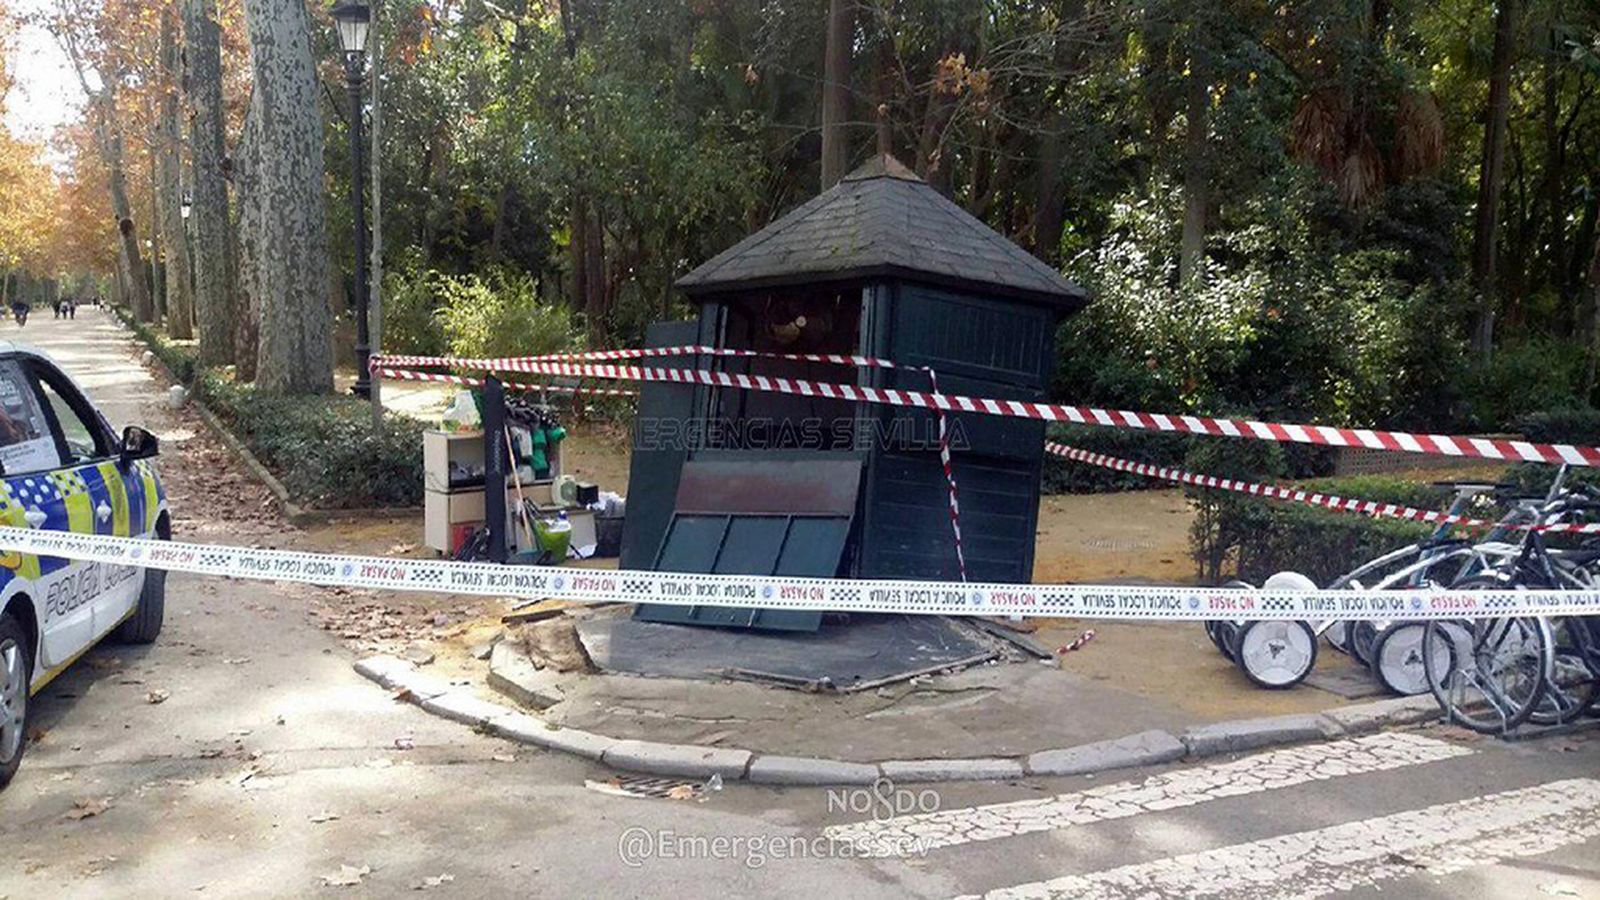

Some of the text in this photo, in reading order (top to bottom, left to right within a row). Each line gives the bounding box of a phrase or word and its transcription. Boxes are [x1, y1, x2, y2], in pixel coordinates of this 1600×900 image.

[360, 565, 406, 580] NO PASAR
[572, 577, 616, 591] NO PASAR
[780, 586, 824, 600] NO PASAR
[990, 592, 1035, 606] NO PASAR
[1208, 596, 1255, 609] NO PASAR
[1430, 596, 1477, 608] NO PASAR
